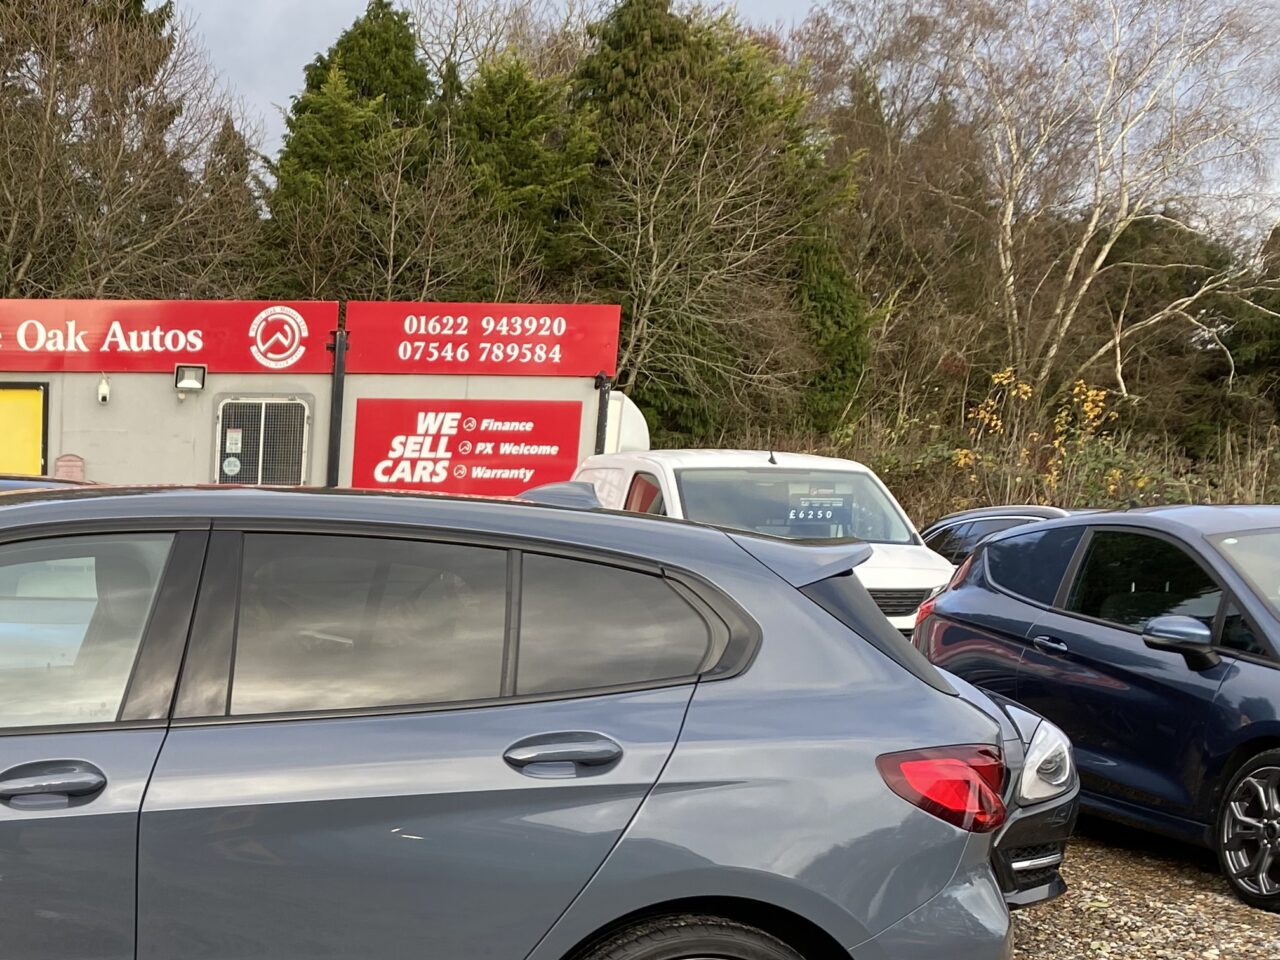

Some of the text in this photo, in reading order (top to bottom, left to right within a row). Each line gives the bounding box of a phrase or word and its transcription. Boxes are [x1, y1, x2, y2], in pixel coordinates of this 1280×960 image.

[17, 320, 89, 352] Oak
[100, 321, 203, 352] Autos
[404, 316, 566, 336] 01622 943920
[399, 341, 561, 362] 07546 789584
[417, 412, 461, 435] WE
[481, 419, 533, 431] Finance
[388, 436, 452, 458] SELL
[475, 443, 559, 455] PX Welcome
[374, 460, 449, 483] CARS
[472, 467, 534, 482] Warranty
